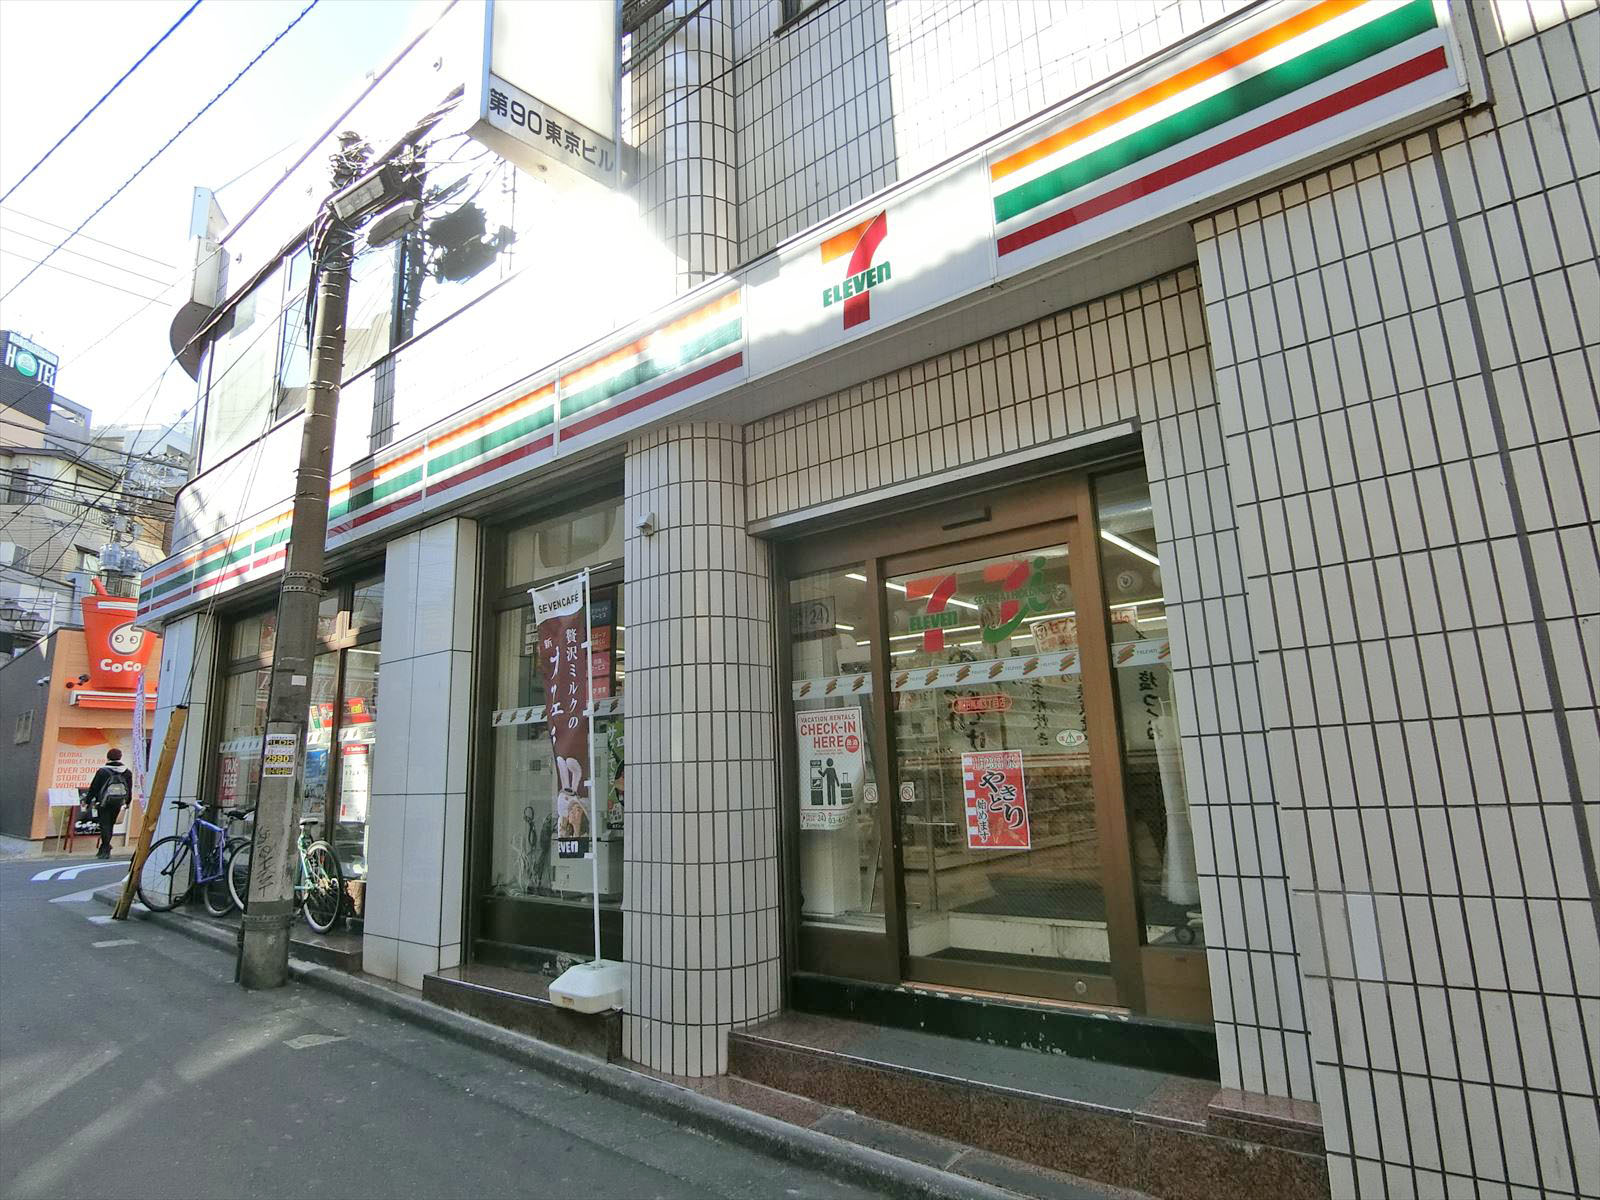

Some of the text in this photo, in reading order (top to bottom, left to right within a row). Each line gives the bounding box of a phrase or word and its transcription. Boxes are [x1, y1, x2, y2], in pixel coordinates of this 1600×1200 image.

[490, 88, 614, 172] 第90東京ビル
[566, 628, 579, 729] 贅沢ミルクの
[800, 720, 857, 736] CHECK-IN
[813, 735, 844, 749] HERE
[56, 774, 87, 782] STORES
[979, 770, 1025, 829] やきとり
[976, 799, 991, 842] 始めます
